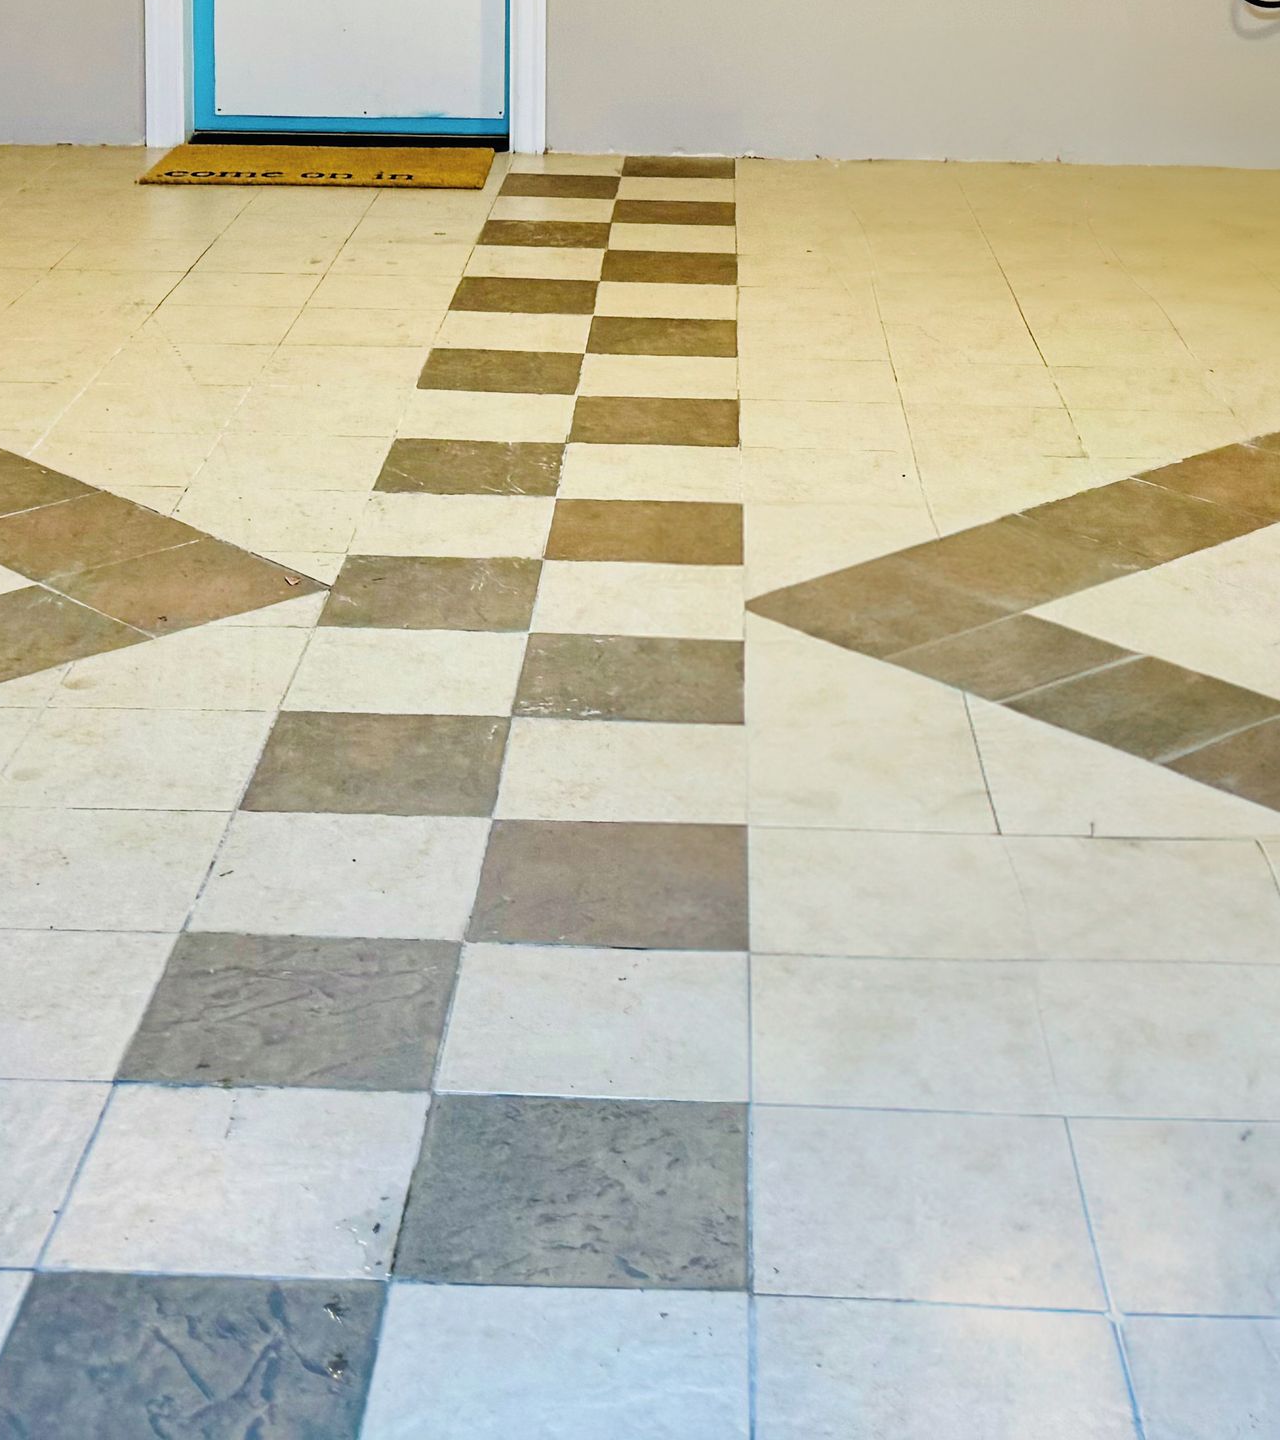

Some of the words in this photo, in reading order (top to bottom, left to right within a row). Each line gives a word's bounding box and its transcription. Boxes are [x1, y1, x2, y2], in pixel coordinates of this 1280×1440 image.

[163, 169, 285, 178] come
[300, 171, 353, 179] on
[374, 170, 414, 180] in
